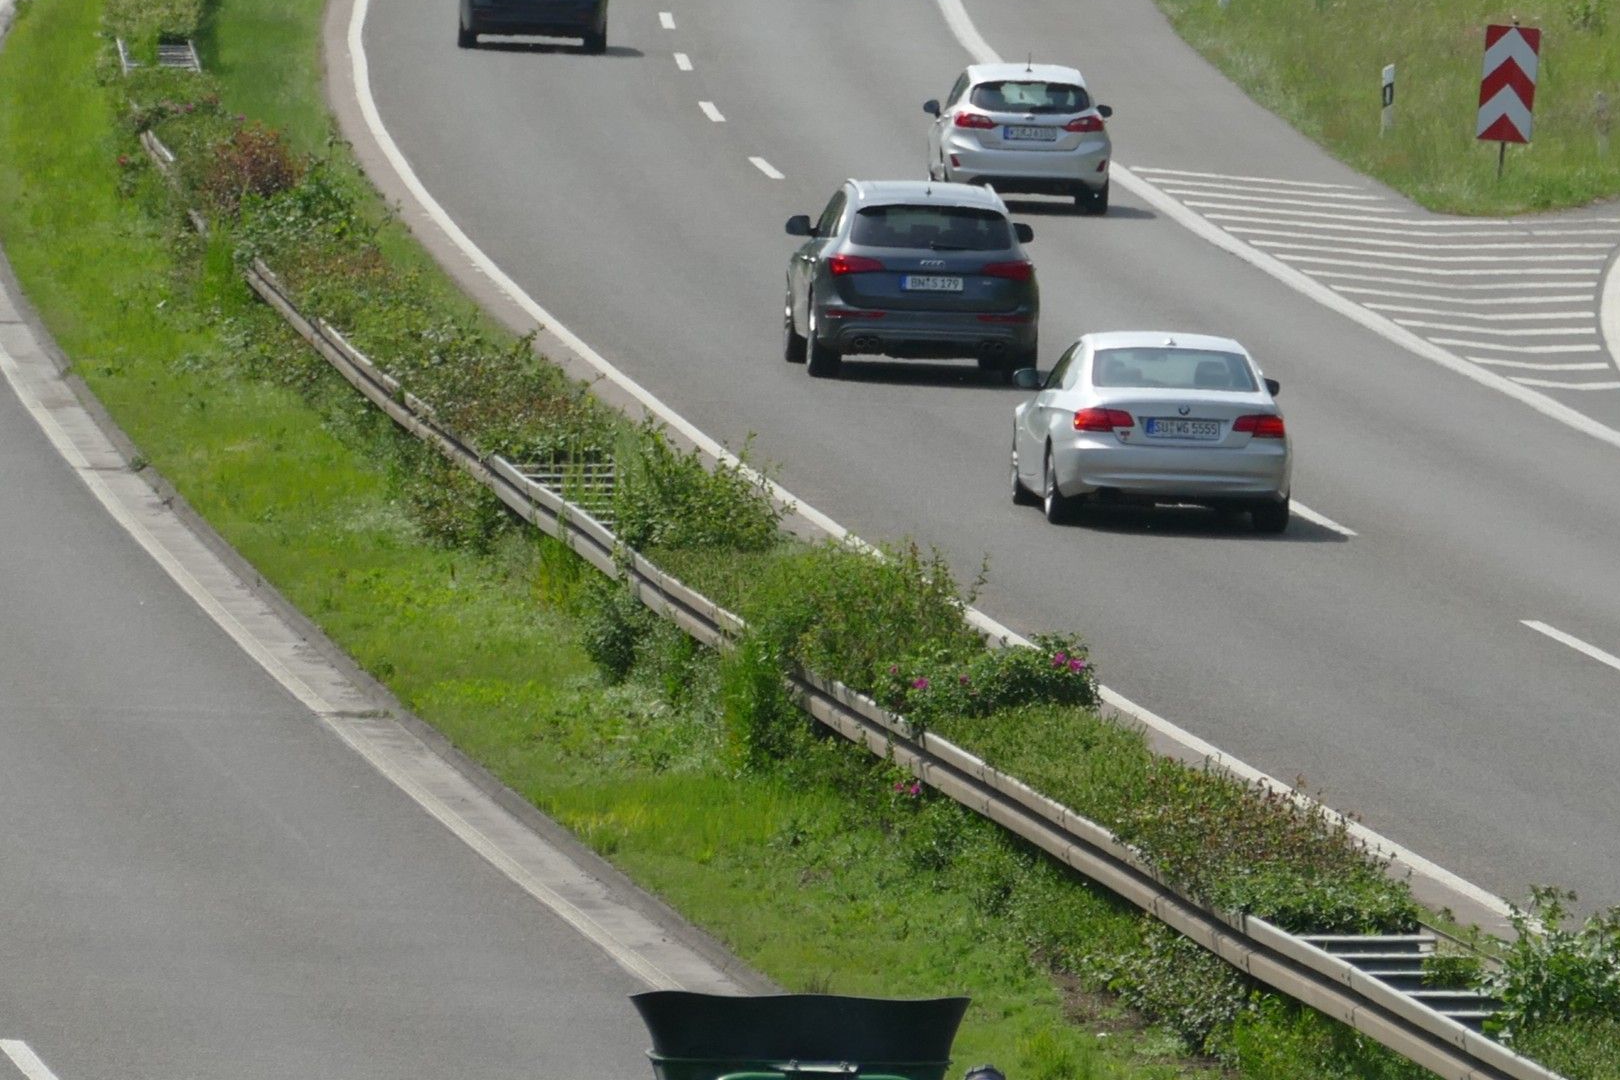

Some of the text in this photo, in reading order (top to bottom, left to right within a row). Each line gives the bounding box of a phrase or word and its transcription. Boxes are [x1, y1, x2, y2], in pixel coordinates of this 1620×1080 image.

[941, 278, 959, 289] 179
[1155, 421, 1168, 432] SU
[1192, 423, 1218, 435] 5555
